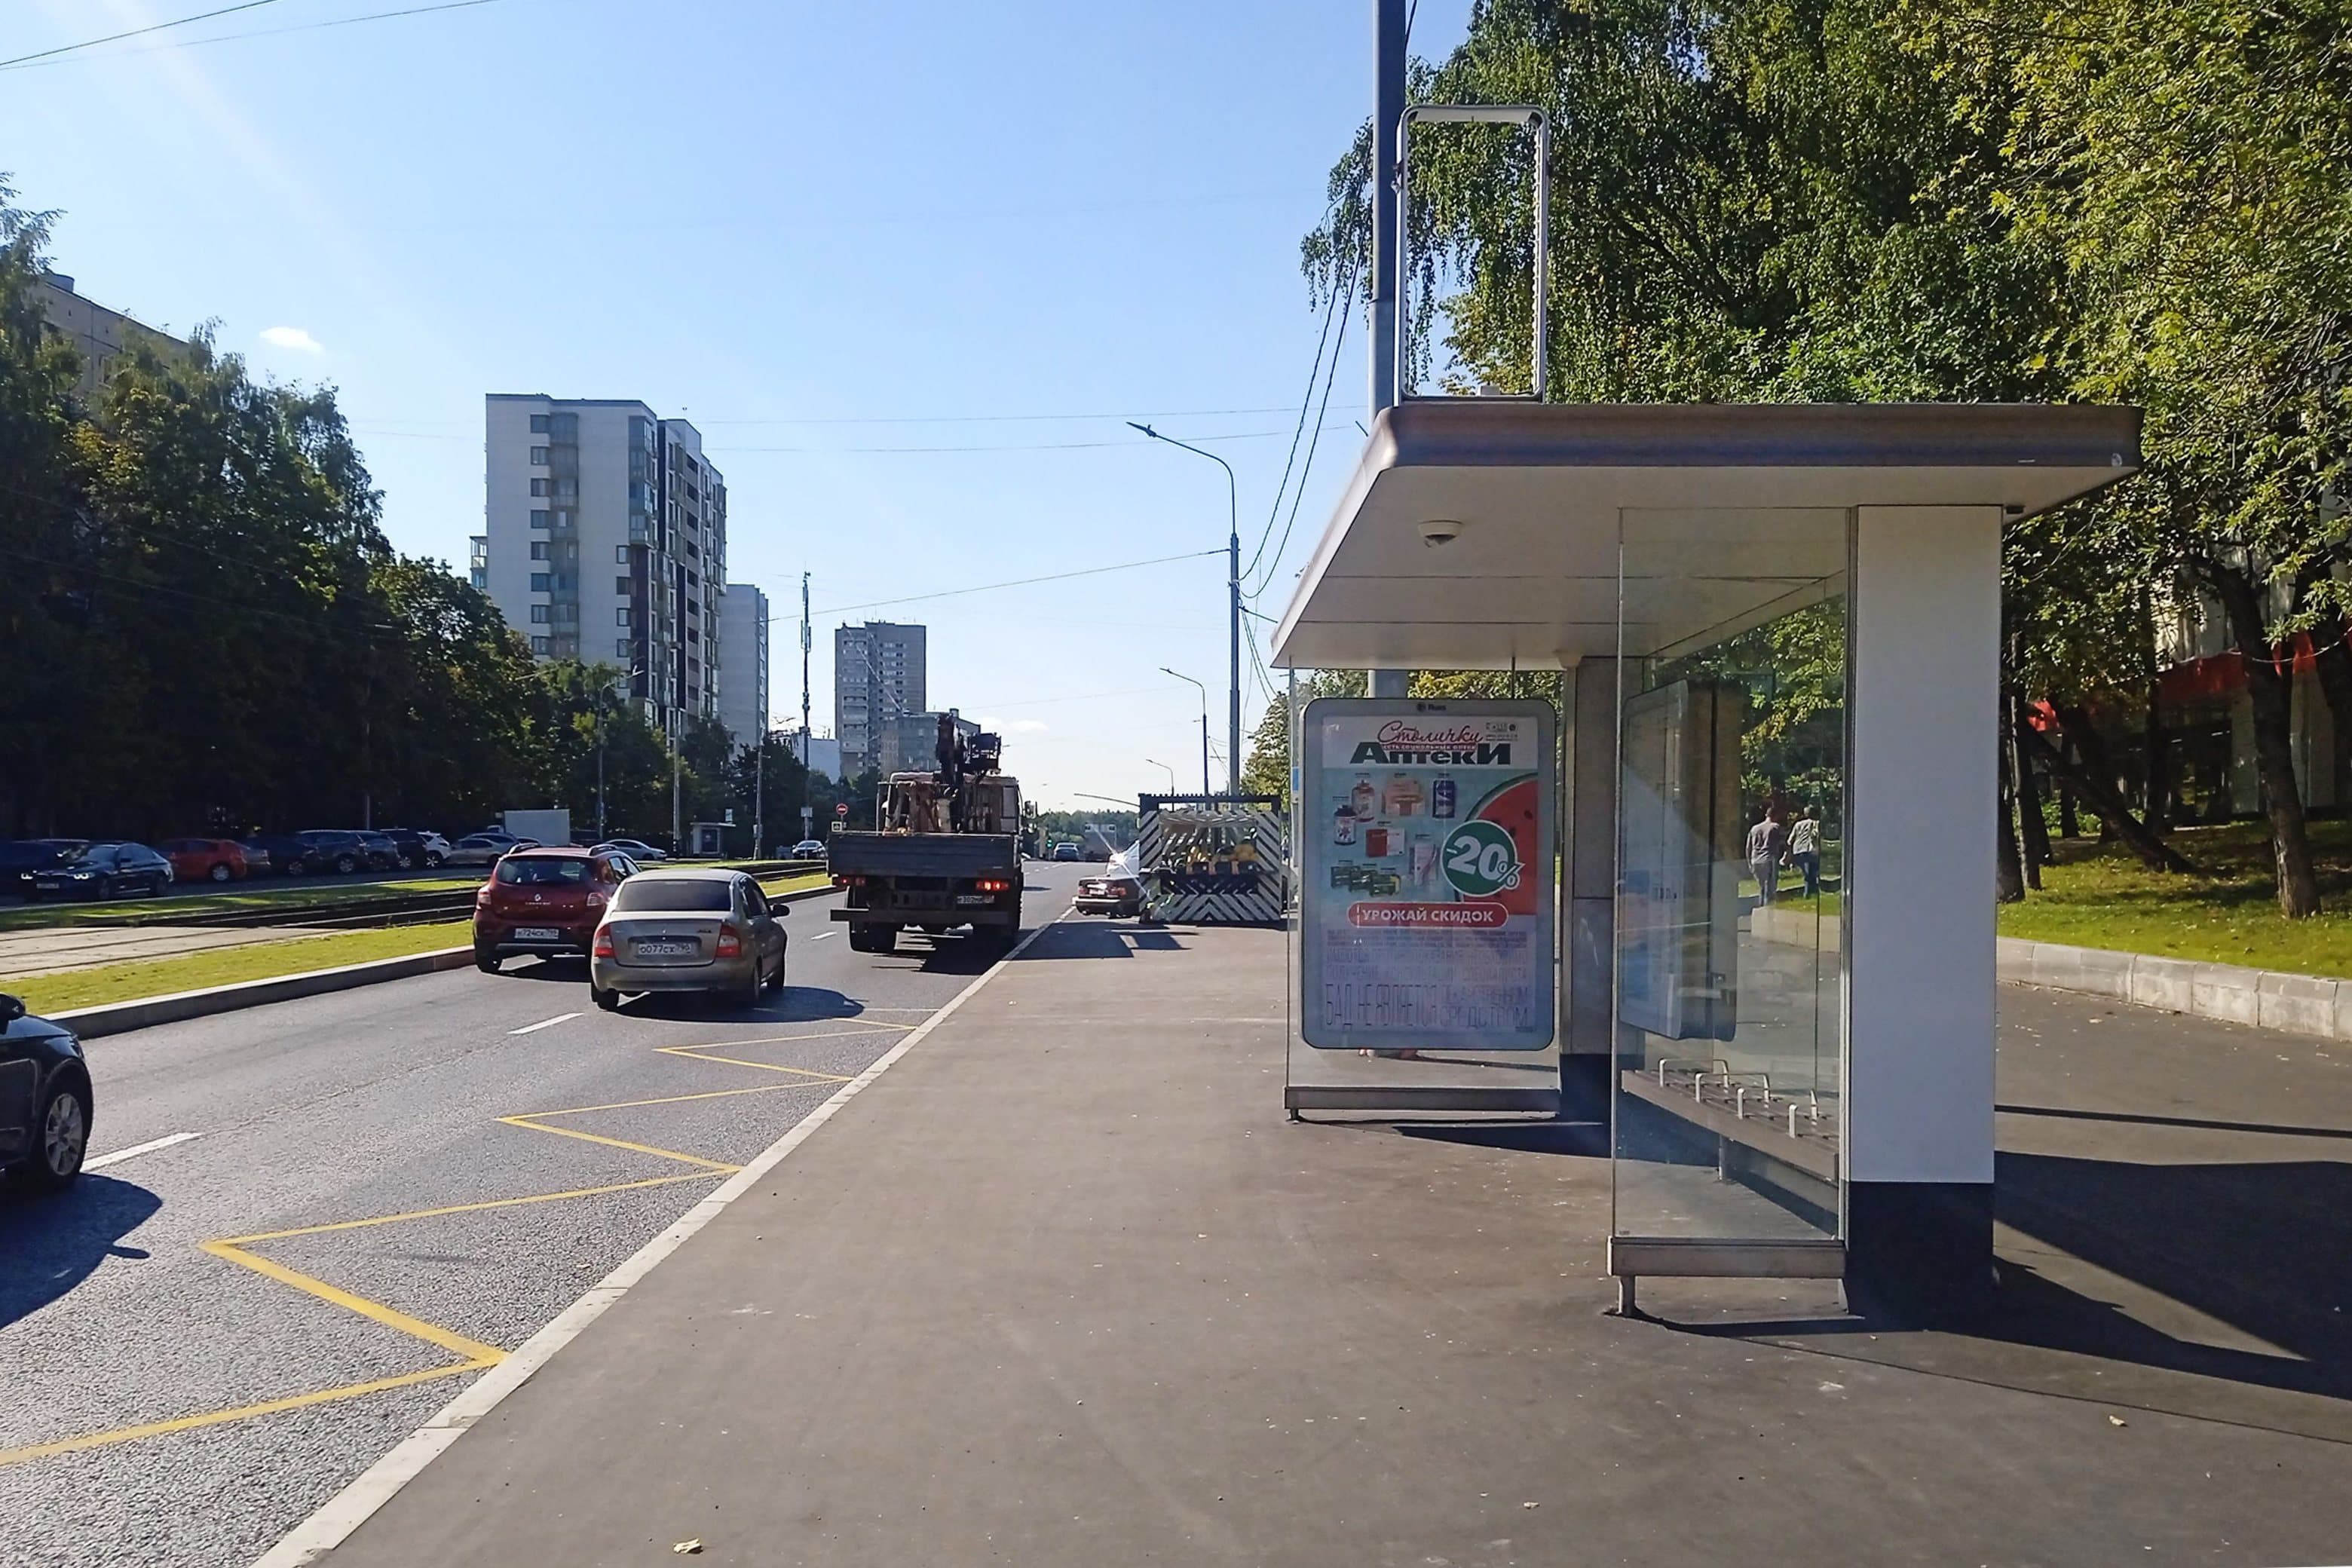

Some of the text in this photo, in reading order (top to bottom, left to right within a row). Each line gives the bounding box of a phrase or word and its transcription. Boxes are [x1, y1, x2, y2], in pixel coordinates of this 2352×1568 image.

[1377, 720, 1484, 743] Столички
[1362, 907, 1493, 923] УРОЖАЙ СКИДОК
